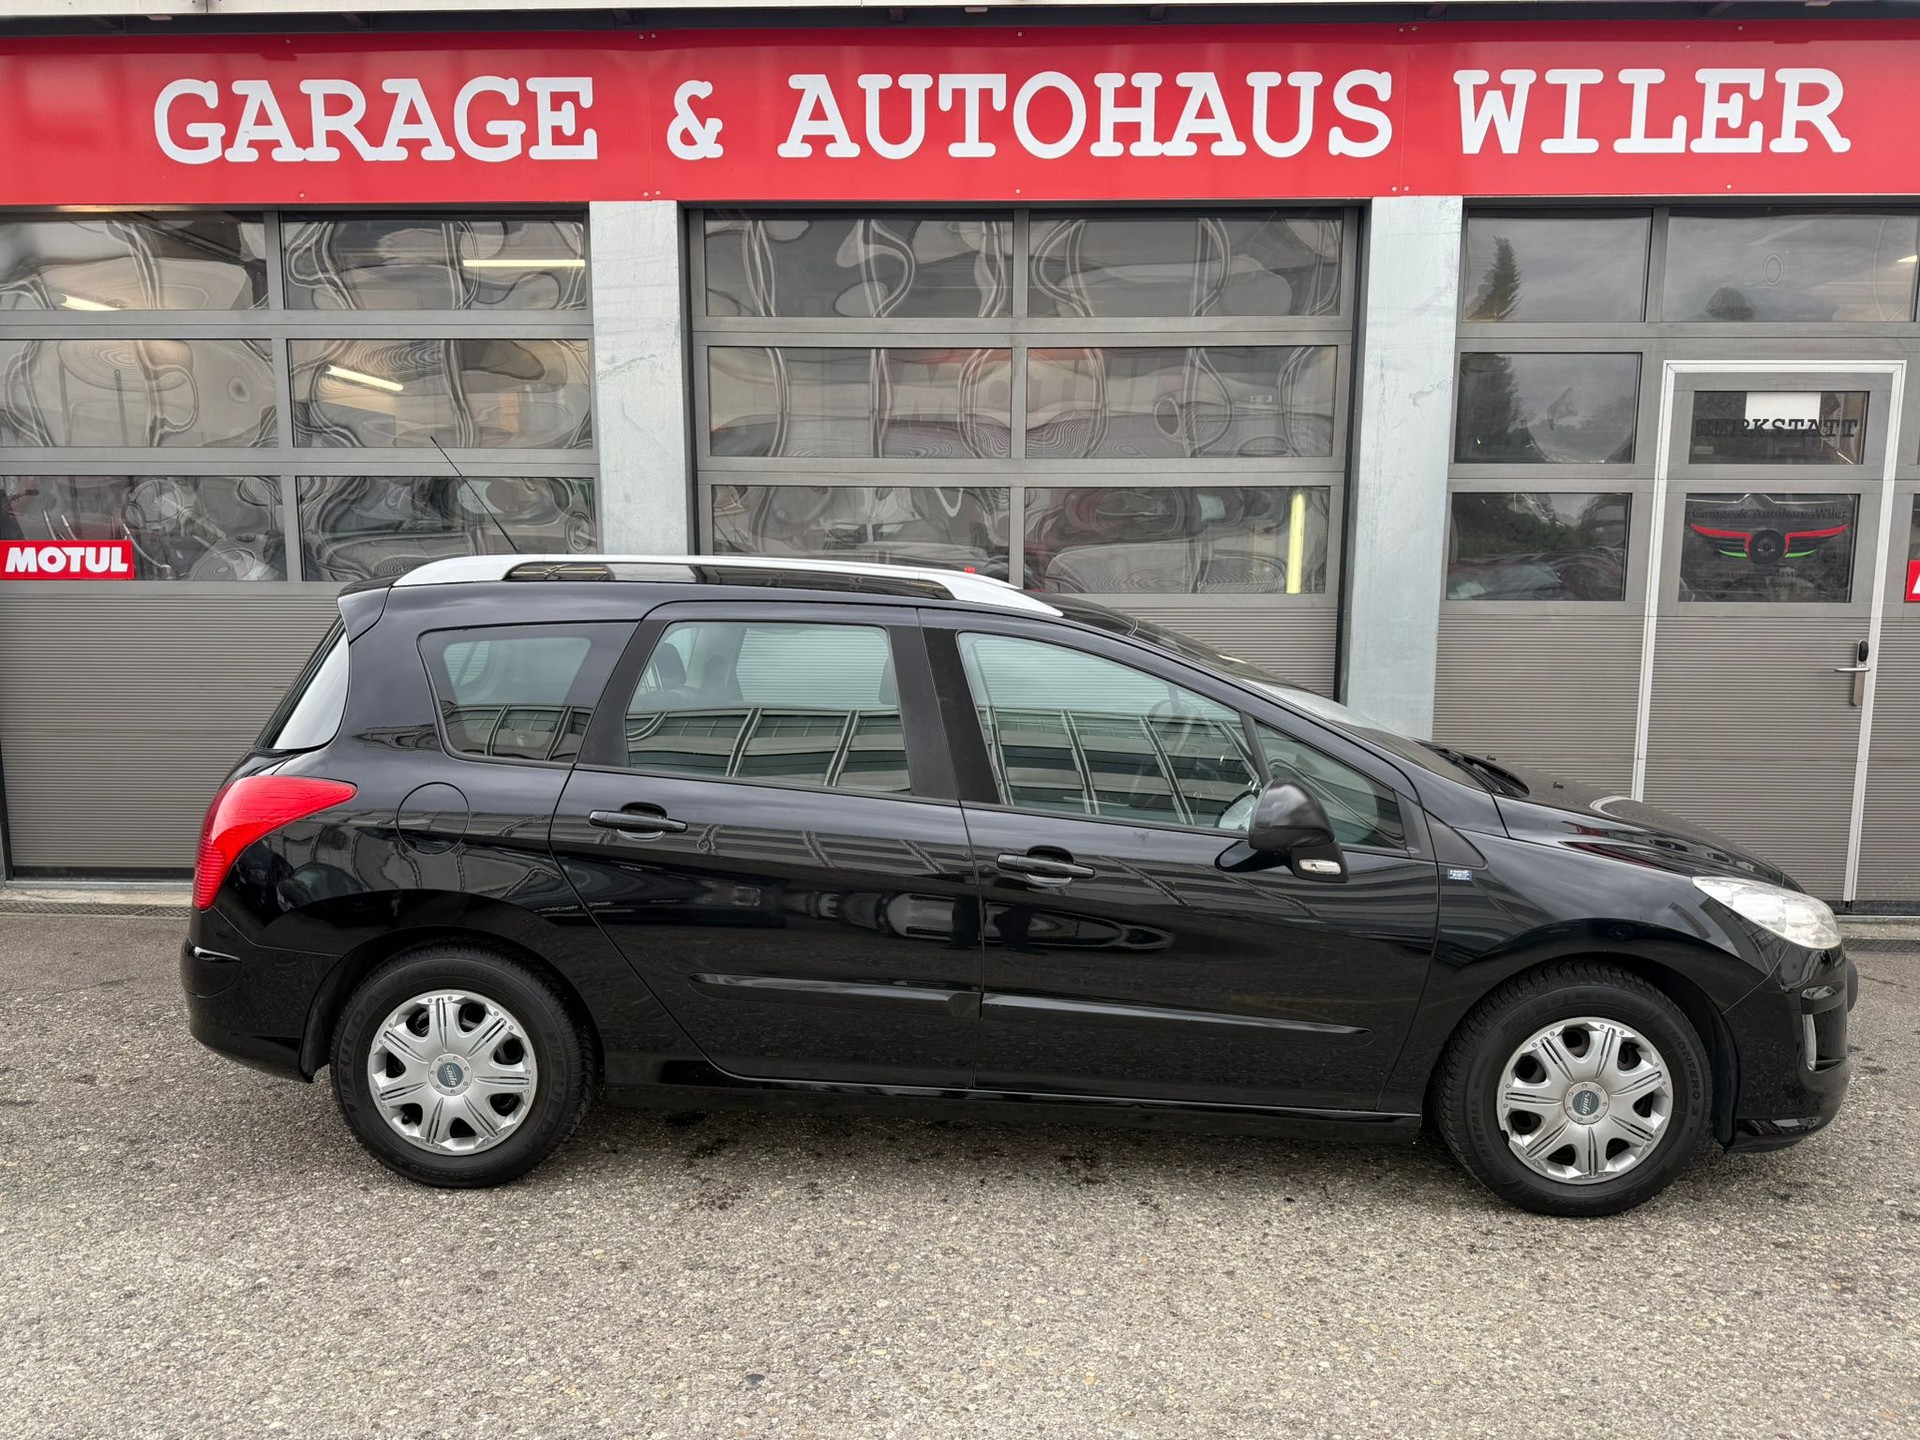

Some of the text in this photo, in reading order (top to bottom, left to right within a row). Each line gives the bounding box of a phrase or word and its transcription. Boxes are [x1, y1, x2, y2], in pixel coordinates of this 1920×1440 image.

[154, 68, 1852, 164] GARAGE & AUTOHAUS WILER
[5, 546, 129, 573] MOTUL
